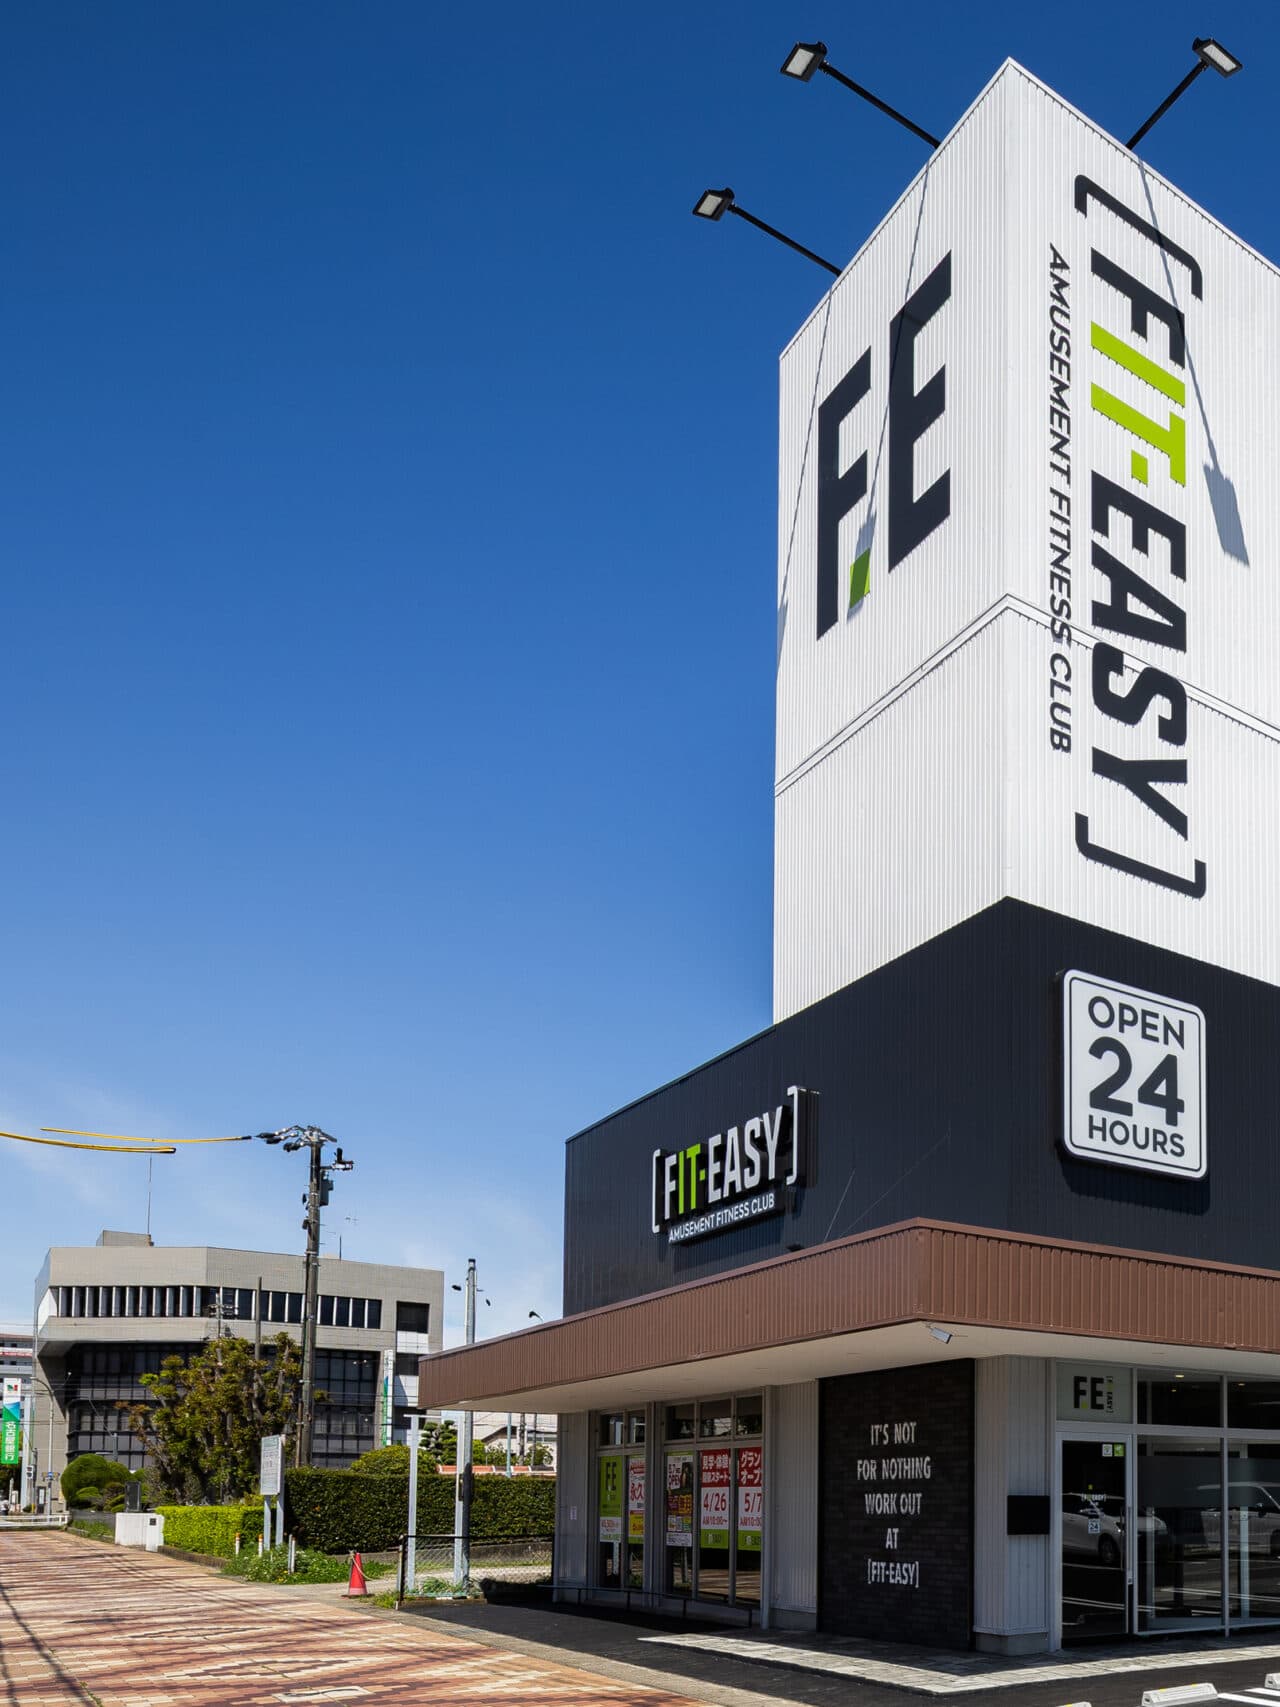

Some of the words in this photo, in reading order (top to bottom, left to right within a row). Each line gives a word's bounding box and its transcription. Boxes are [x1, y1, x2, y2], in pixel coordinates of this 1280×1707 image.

[1049, 242, 1071, 488] AMUSEMENT
[1049, 487, 1072, 648] FITNESS
[1050, 653, 1072, 755] CLUB
[1088, 996, 1185, 1050] OPEN
[1088, 1036, 1185, 1127] 24
[1088, 1114, 1185, 1157] HOURS
[668, 1214, 715, 1243] AMUSEMENT
[716, 1204, 750, 1227] FITNESS
[751, 1193, 776, 1214] CLUB
[871, 1424, 889, 1446] IT'S
[894, 1422, 917, 1444] NOT
[857, 1459, 877, 1481] FOR
[882, 1456, 932, 1480] NOTHING
[703, 1492, 728, 1512] 4/26
[865, 1493, 897, 1515] WORK
[900, 1493, 922, 1515] OUT
[885, 1528, 899, 1549] AT
